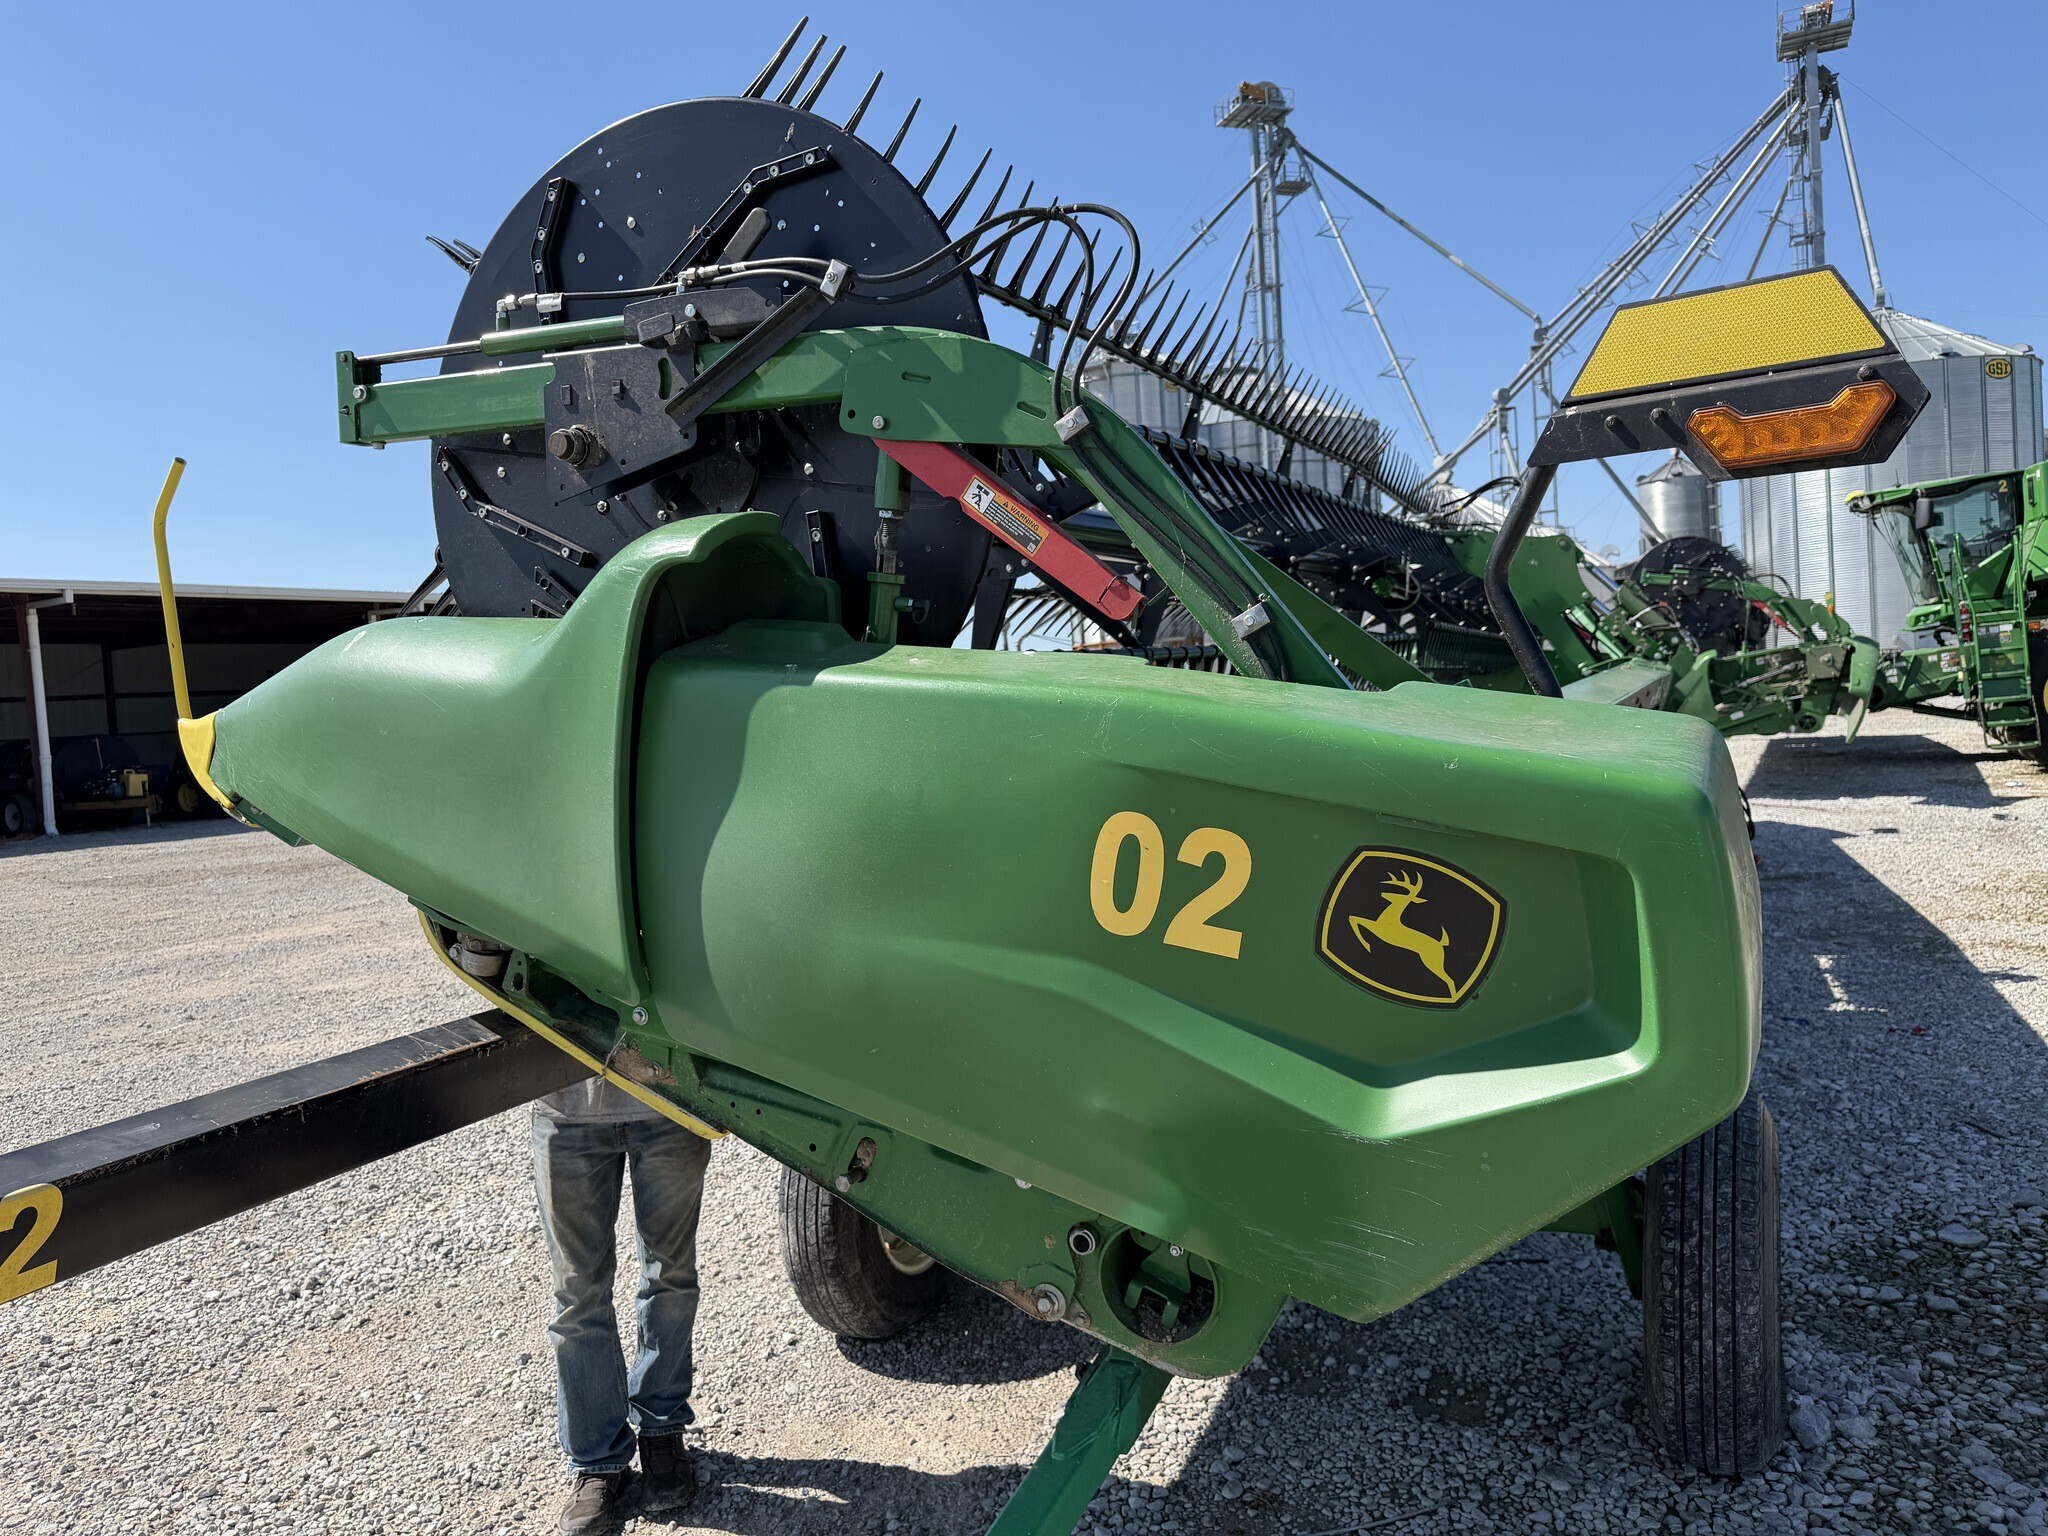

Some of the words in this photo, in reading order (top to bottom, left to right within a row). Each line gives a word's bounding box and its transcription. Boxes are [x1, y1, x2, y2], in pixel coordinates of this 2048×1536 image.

[1988, 361, 2009, 376] GSI
[1998, 479, 2008, 493] 2
[1010, 505, 1040, 531] WARNING
[1090, 811, 1252, 959] 02
[0, 1183, 64, 1304] 2
